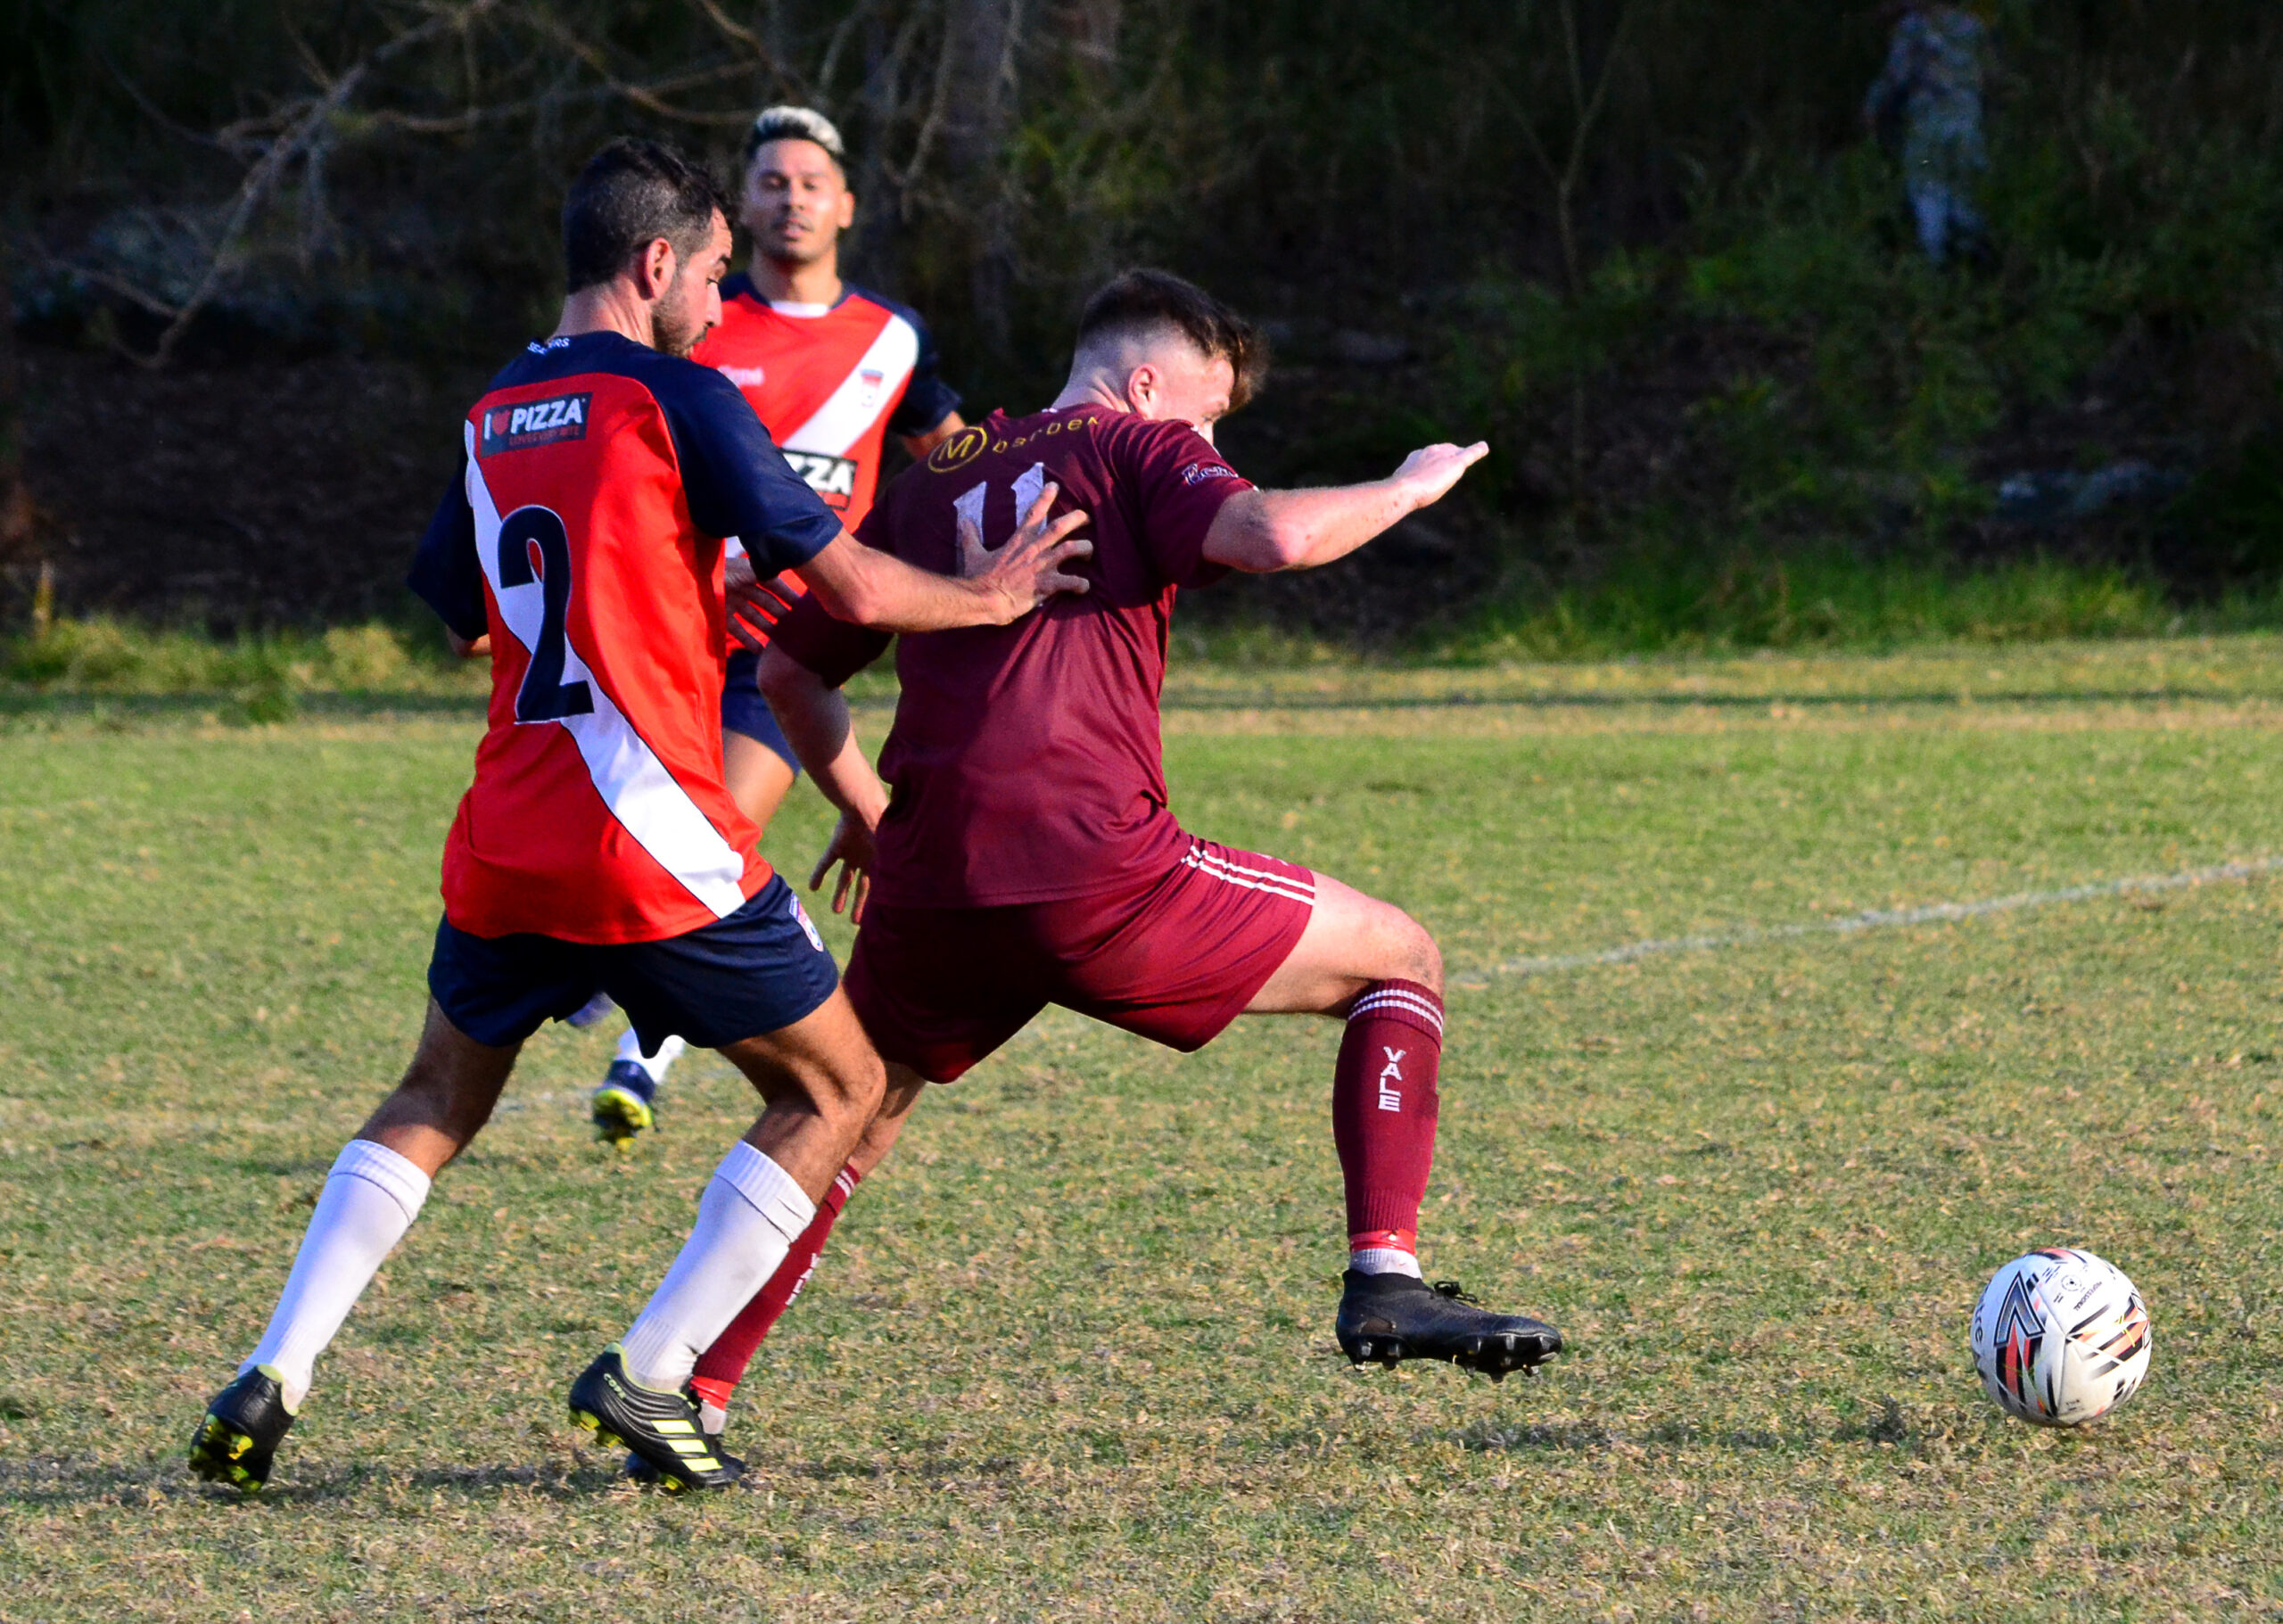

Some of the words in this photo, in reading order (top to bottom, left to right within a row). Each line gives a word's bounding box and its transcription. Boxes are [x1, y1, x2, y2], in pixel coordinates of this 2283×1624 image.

[484, 412, 492, 441] I
[510, 398, 583, 435] PIZZA
[498, 504, 595, 725] 2
[1378, 1045, 1406, 1113] VALE
